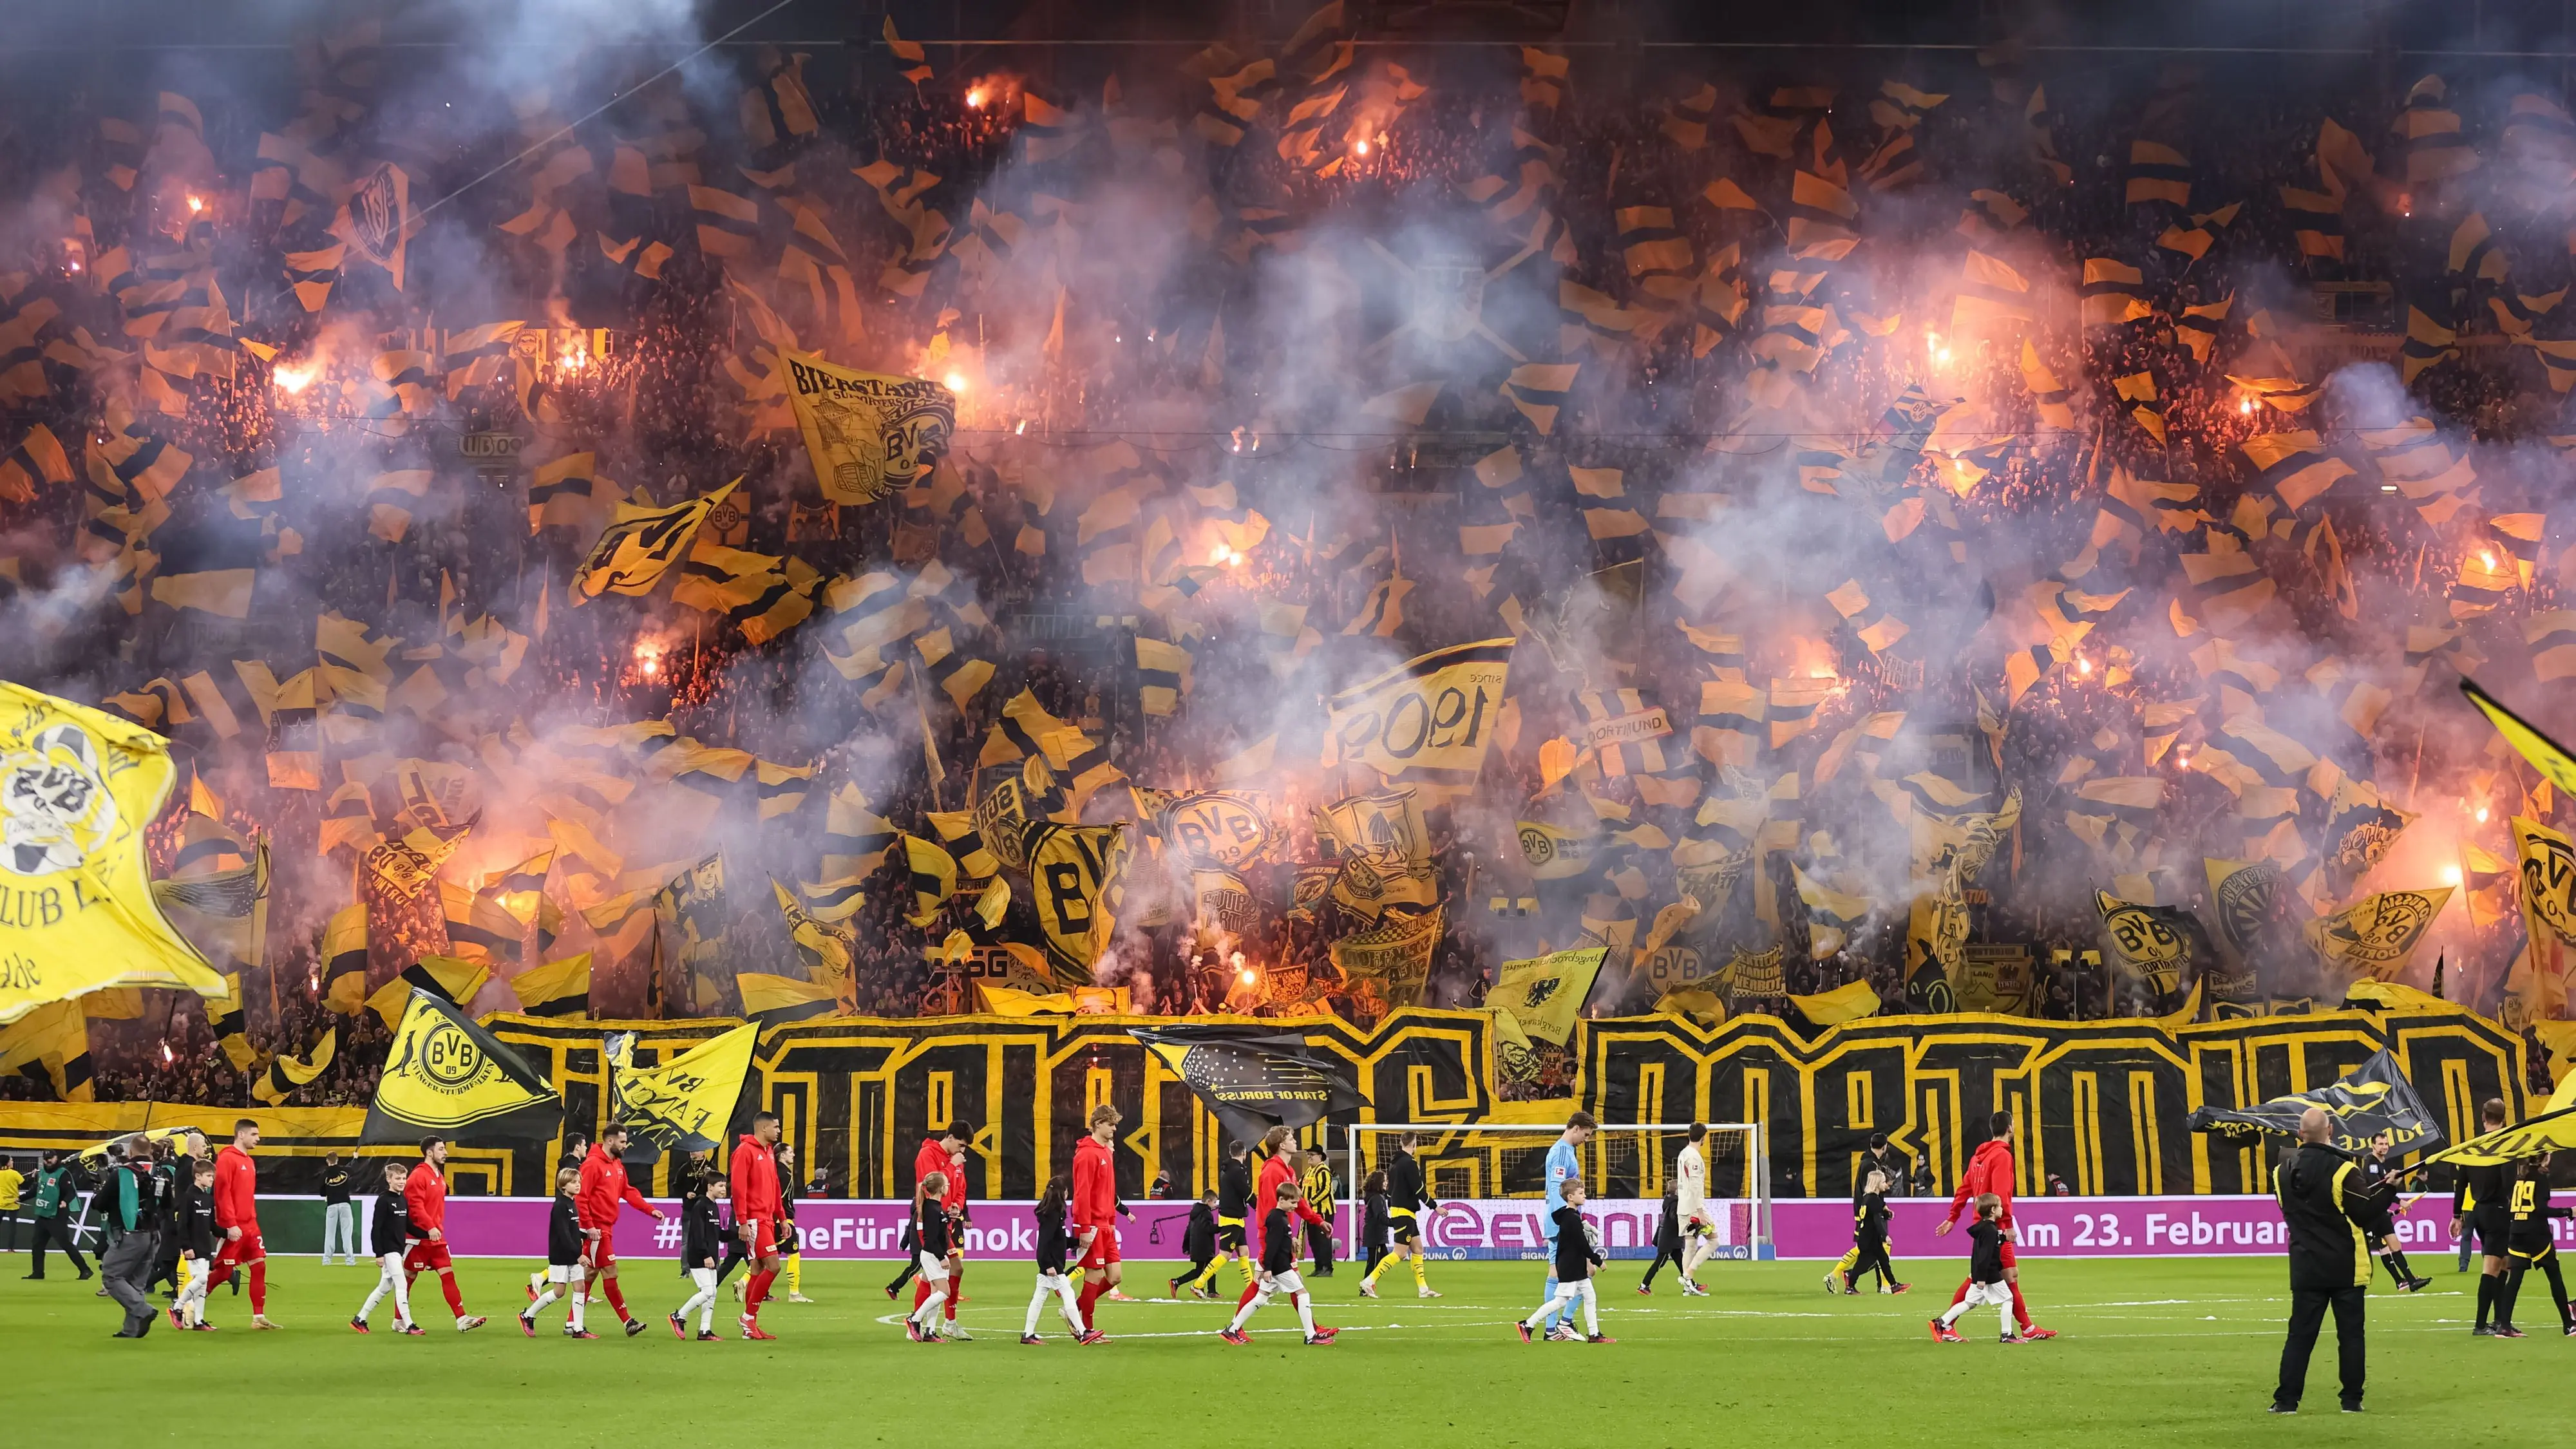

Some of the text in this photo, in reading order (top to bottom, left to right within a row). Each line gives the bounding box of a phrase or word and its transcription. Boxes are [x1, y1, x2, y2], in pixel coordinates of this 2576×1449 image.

[715, 507, 735, 522] BVB
[1587, 715, 1663, 743] DORTMUND
[1178, 805, 1258, 857] BVB
[1522, 831, 1549, 856] BVB
[1215, 846, 1241, 861] 09
[0, 885, 62, 928] LUB
[2113, 914, 2175, 953] BVB
[1653, 949, 1698, 980] BVB
[431, 1032, 474, 1066] BVB
[446, 1065, 457, 1075] 09
[2510, 1180, 2536, 1213] 09
[2072, 1214, 2132, 1247] 23.
[1424, 1251, 1449, 1260] DUNA
[1520, 1251, 1549, 1260] SIGNA
